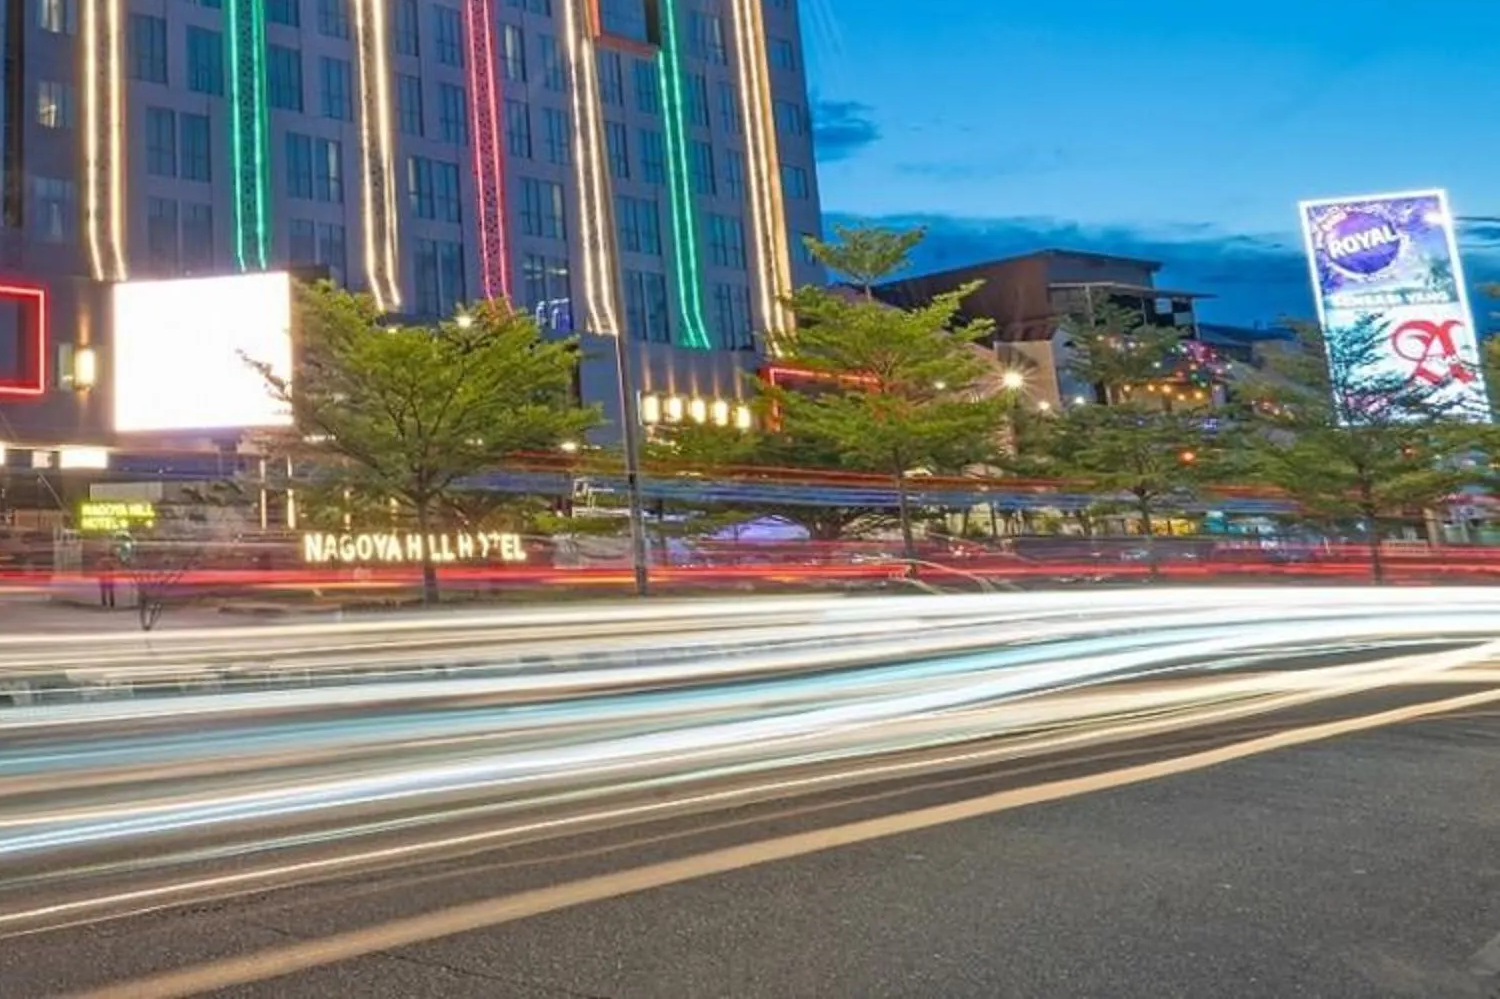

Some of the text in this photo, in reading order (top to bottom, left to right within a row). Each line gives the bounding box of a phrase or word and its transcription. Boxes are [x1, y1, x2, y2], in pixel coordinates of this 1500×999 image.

[1329, 223, 1399, 260] ROYAL
[303, 533, 402, 562] NAGOYA
[406, 533, 456, 561] HLL
